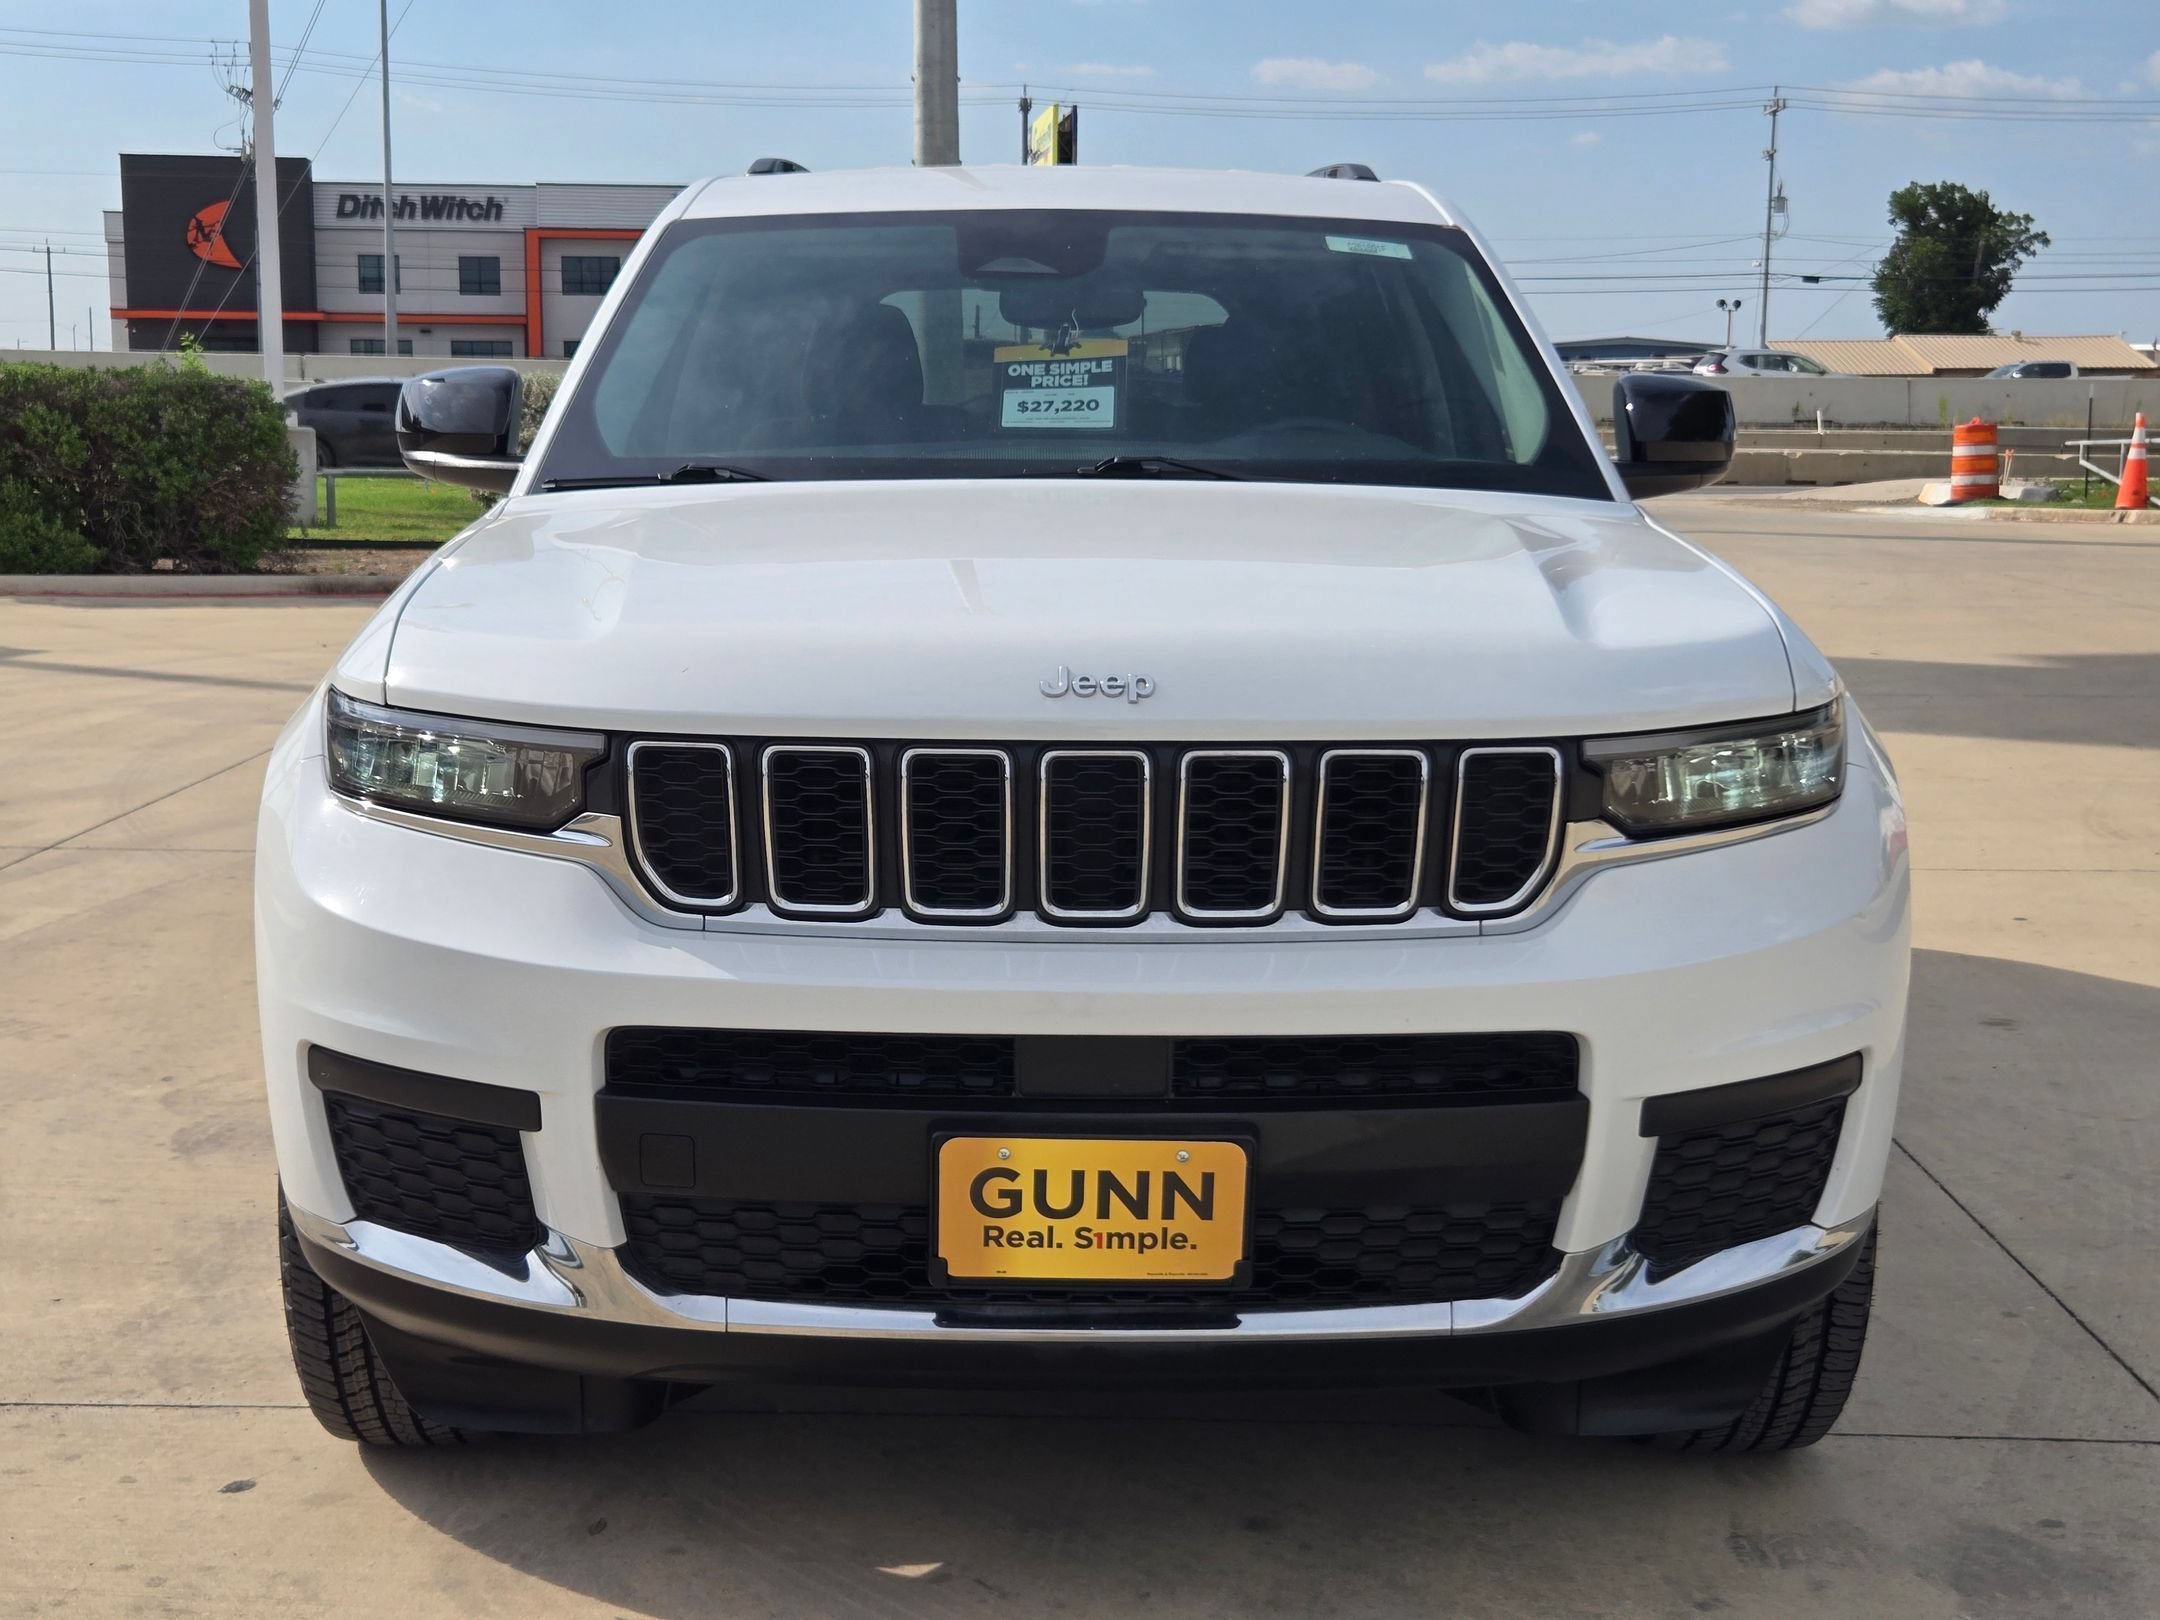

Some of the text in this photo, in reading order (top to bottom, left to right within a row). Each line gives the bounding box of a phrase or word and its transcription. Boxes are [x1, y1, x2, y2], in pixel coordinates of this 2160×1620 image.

[420, 195, 503, 222] Witch
[1007, 359, 1113, 377] ONE SIMPLE
[1030, 374, 1089, 388] PRICE!
[1016, 398, 1100, 415] $27,220
[1039, 664, 1155, 704] Jeep
[969, 1166, 1215, 1221] GUNN
[982, 1225, 1063, 1249] Real.
